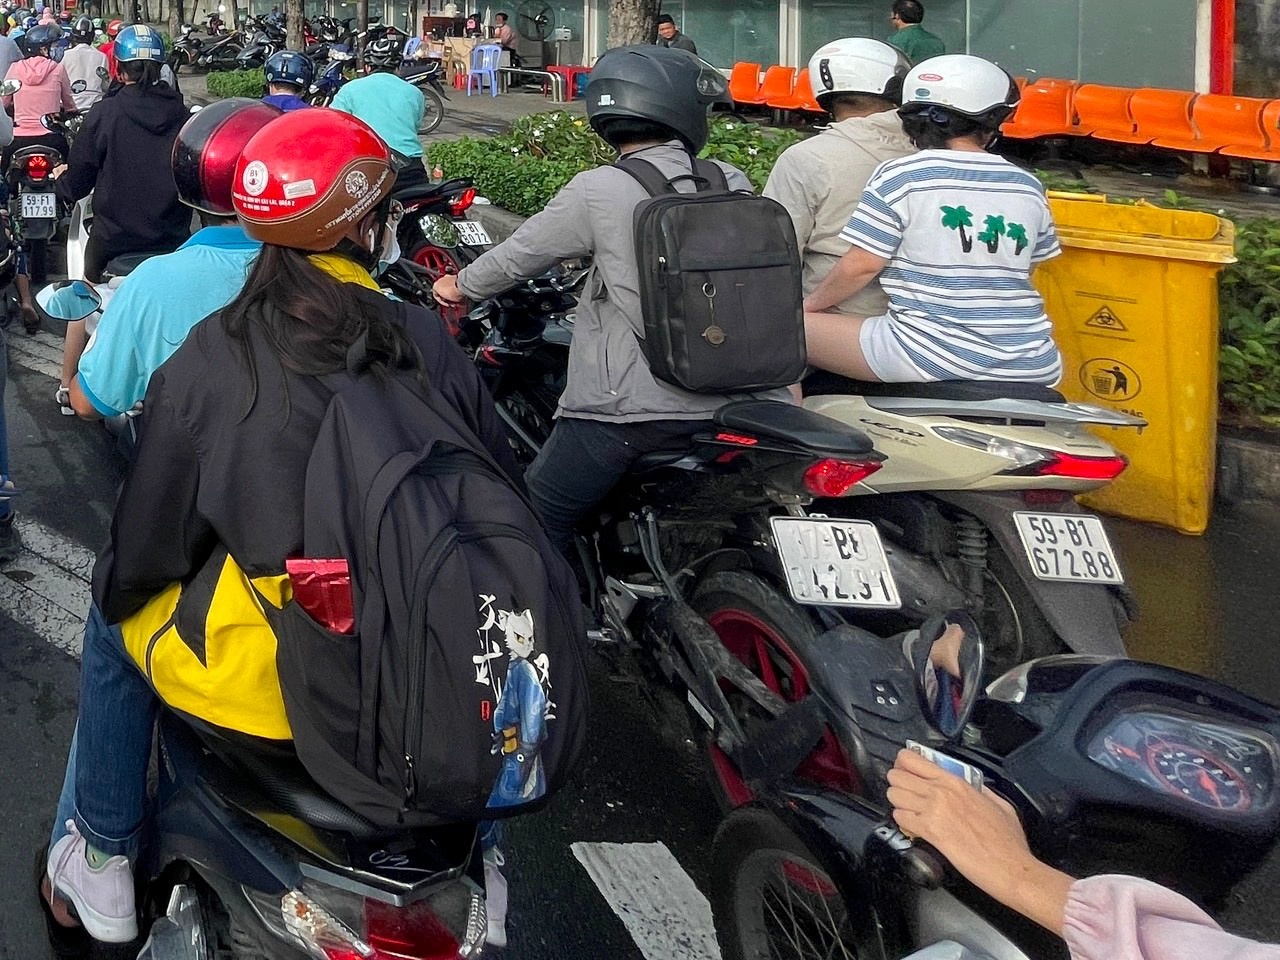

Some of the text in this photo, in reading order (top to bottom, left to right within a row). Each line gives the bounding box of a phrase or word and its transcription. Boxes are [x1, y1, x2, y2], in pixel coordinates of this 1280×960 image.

[27, 195, 49, 205] 59-F1
[24, 206, 53, 216] 117.99
[458, 222, 479, 233] 9-B1
[1028, 517, 1093, 547] 59-B1
[1033, 547, 1114, 578] 672.88
